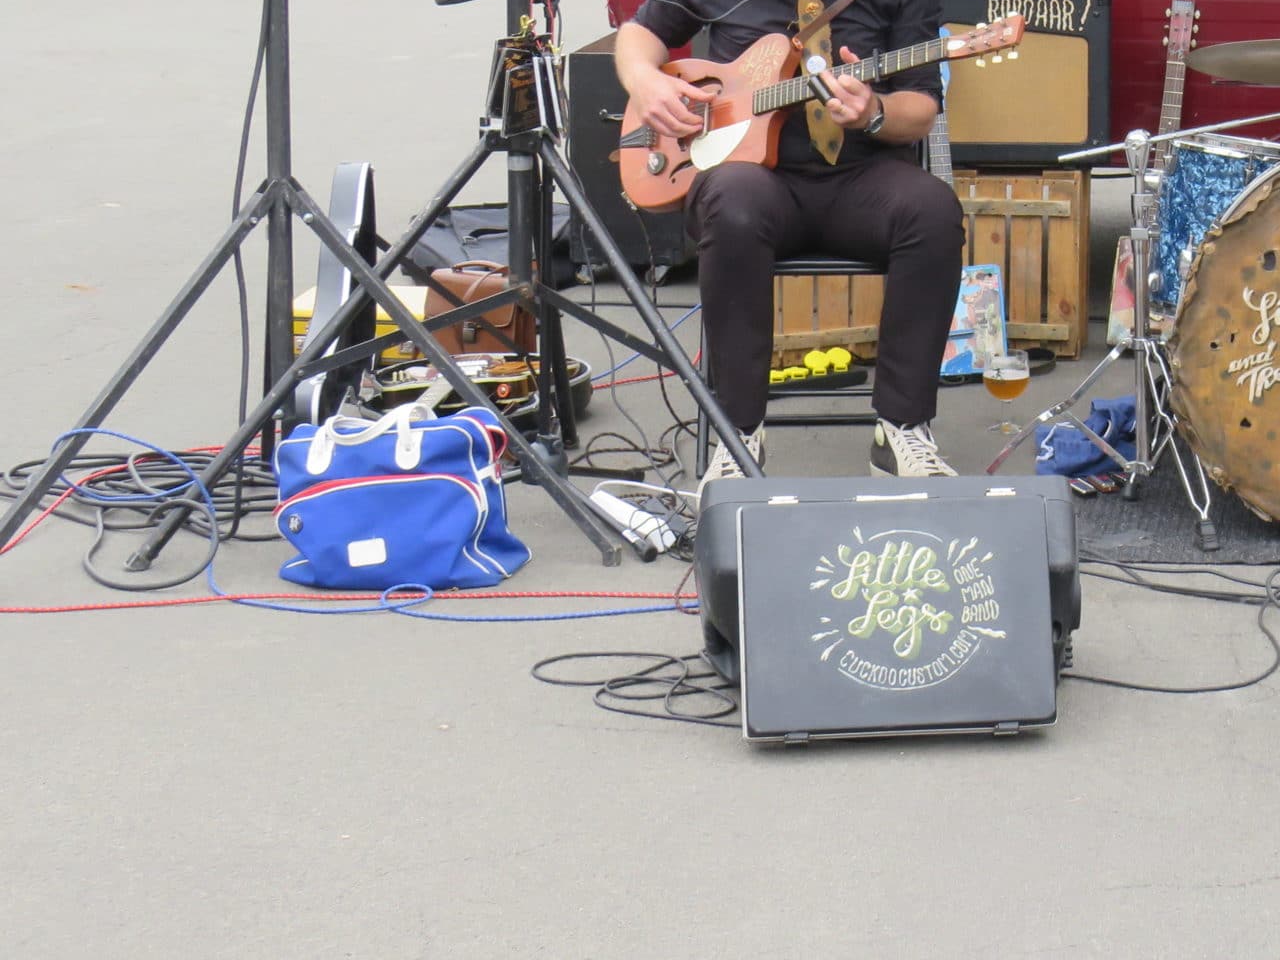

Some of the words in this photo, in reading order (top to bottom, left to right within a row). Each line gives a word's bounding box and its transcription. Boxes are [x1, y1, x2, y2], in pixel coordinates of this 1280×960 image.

[1228, 340, 1277, 374] and
[831, 540, 949, 601] Little
[953, 557, 984, 585] ONE
[960, 575, 995, 603] MAN
[848, 588, 954, 659] Legs
[961, 599, 1000, 624] BAND
